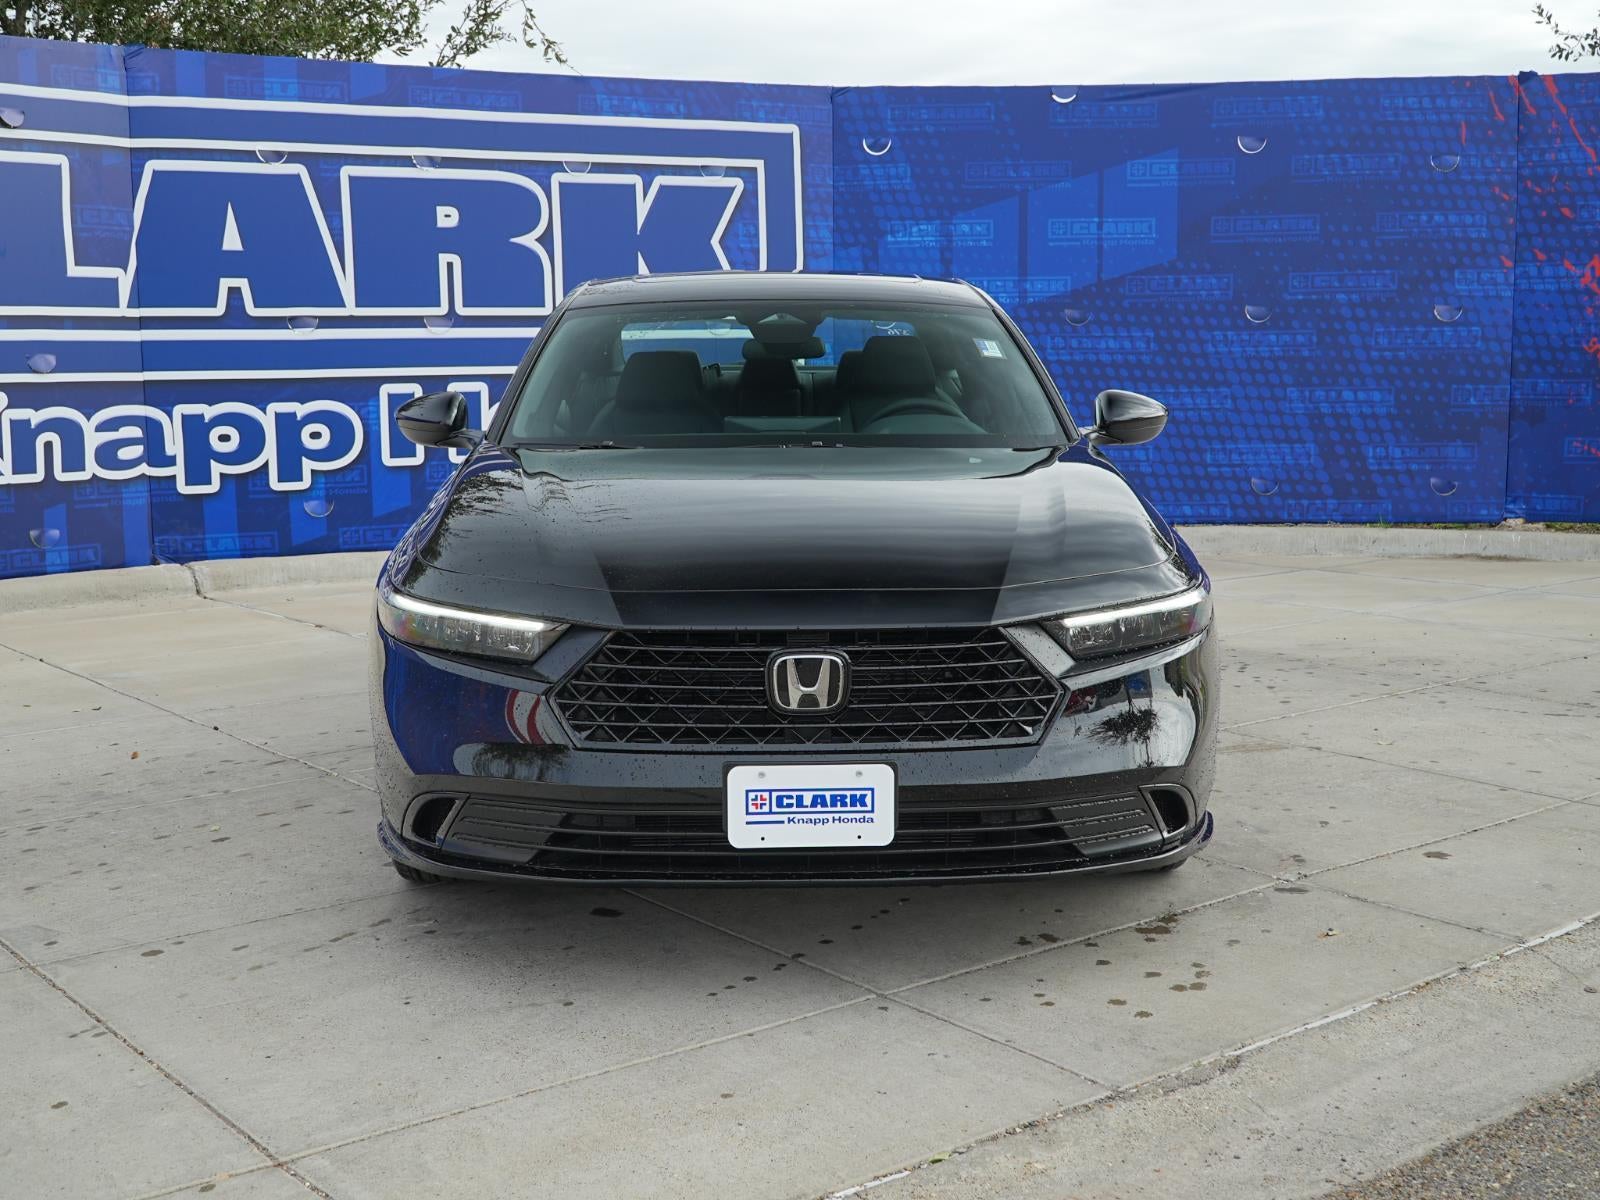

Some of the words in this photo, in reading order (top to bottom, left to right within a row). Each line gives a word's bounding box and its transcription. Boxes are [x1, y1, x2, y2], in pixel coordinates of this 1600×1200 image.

[0, 391, 363, 495] napp
[775, 793, 868, 809] CLARK
[787, 816, 830, 826] Knapp
[832, 815, 874, 824] Honda
